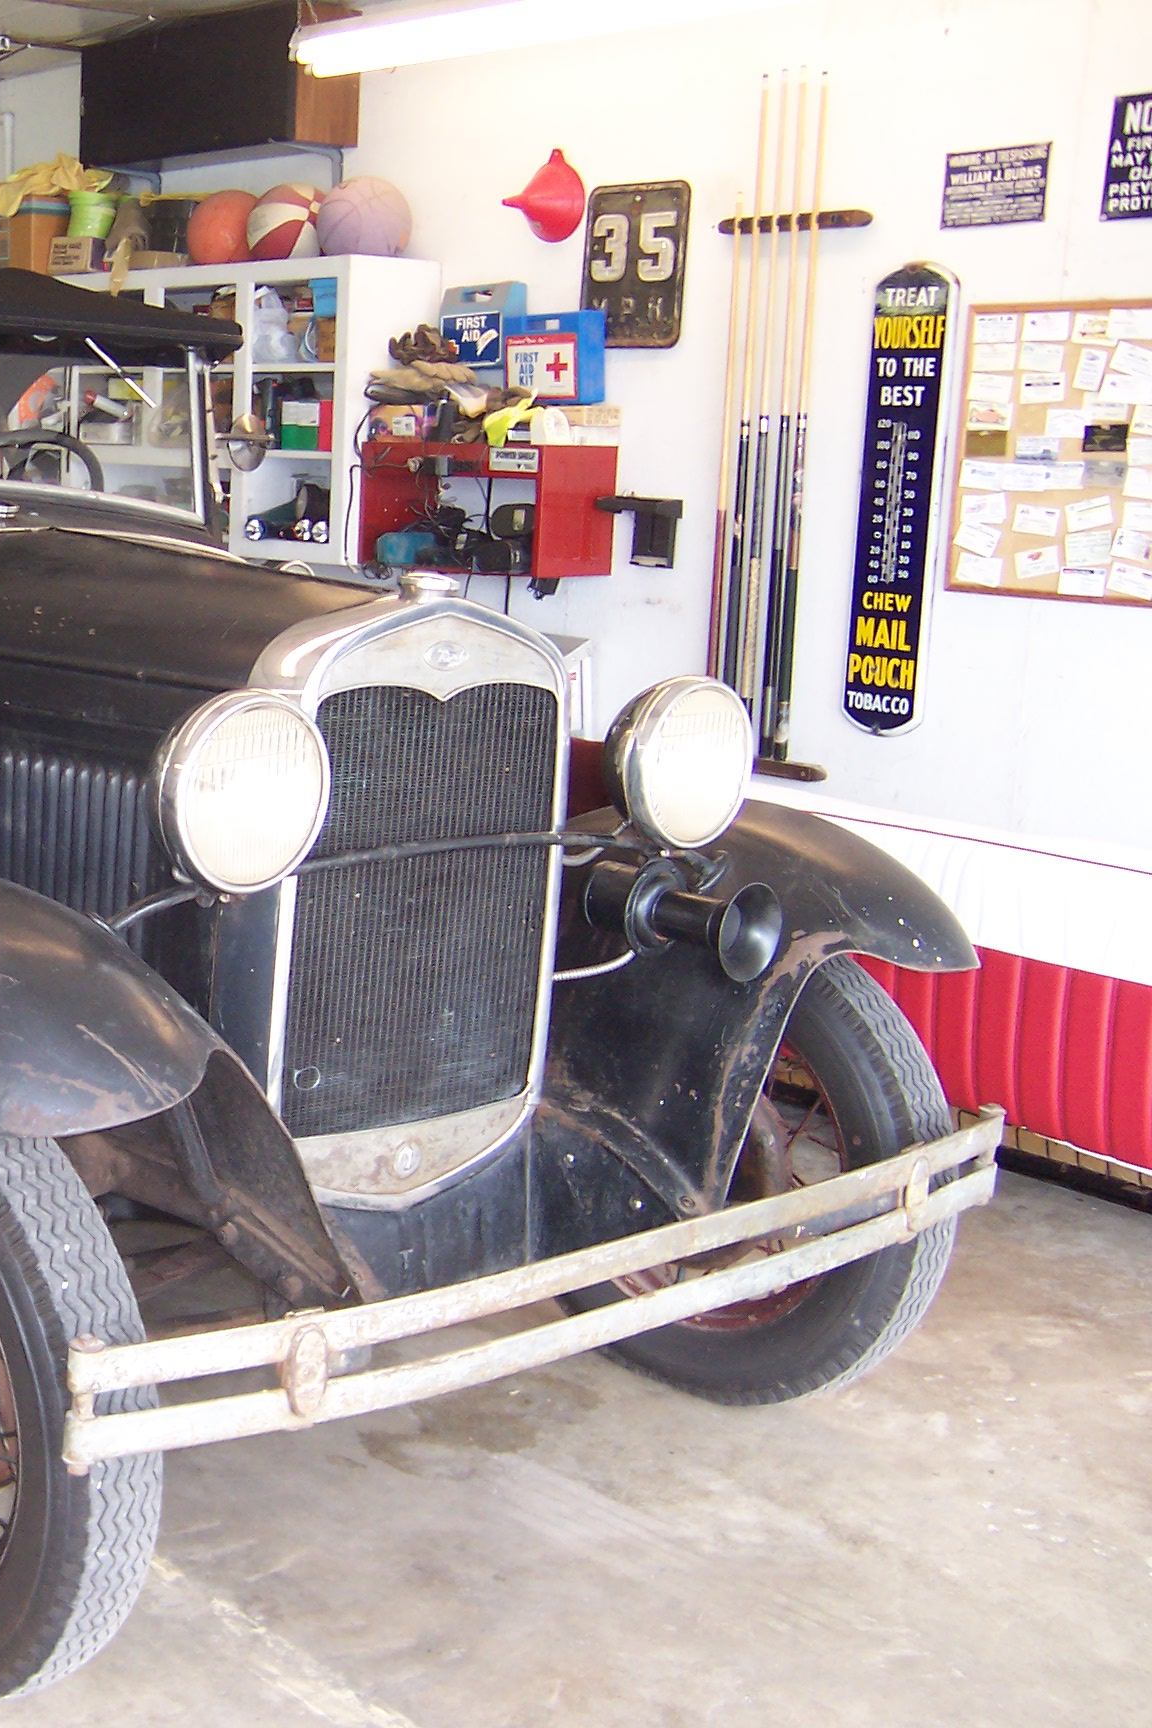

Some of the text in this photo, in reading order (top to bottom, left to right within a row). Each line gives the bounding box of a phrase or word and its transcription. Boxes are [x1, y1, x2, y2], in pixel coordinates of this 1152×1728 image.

[1111, 139, 1122, 153] A
[1110, 152, 1147, 168] MAY
[950, 170, 993, 186] WILLIAM
[1004, 165, 1042, 181] BURNS
[1109, 180, 1152, 198] PREV
[1108, 195, 1152, 212] PROT
[590, 210, 678, 283] 35
[885, 286, 939, 308] TREAT
[455, 316, 488, 331] FIRST
[461, 330, 481, 343] AID
[874, 315, 945, 349] YOURSELF
[515, 351, 539, 363] FIRST
[519, 363, 534, 375] AID
[877, 357, 937, 378] TO THE
[519, 375, 534, 386] KIT
[880, 386, 925, 407] BEST
[906, 471, 918, 480] 70
[872, 514, 883, 523] 20
[873, 531, 882, 539] 0
[902, 524, 913, 534] 10
[869, 545, 881, 555] 20
[901, 540, 912, 549] 10
[862, 591, 912, 612] CHEW
[855, 616, 911, 651] MAIL
[848, 653, 915, 690] POUCH
[847, 690, 909, 715] TOBACCO
